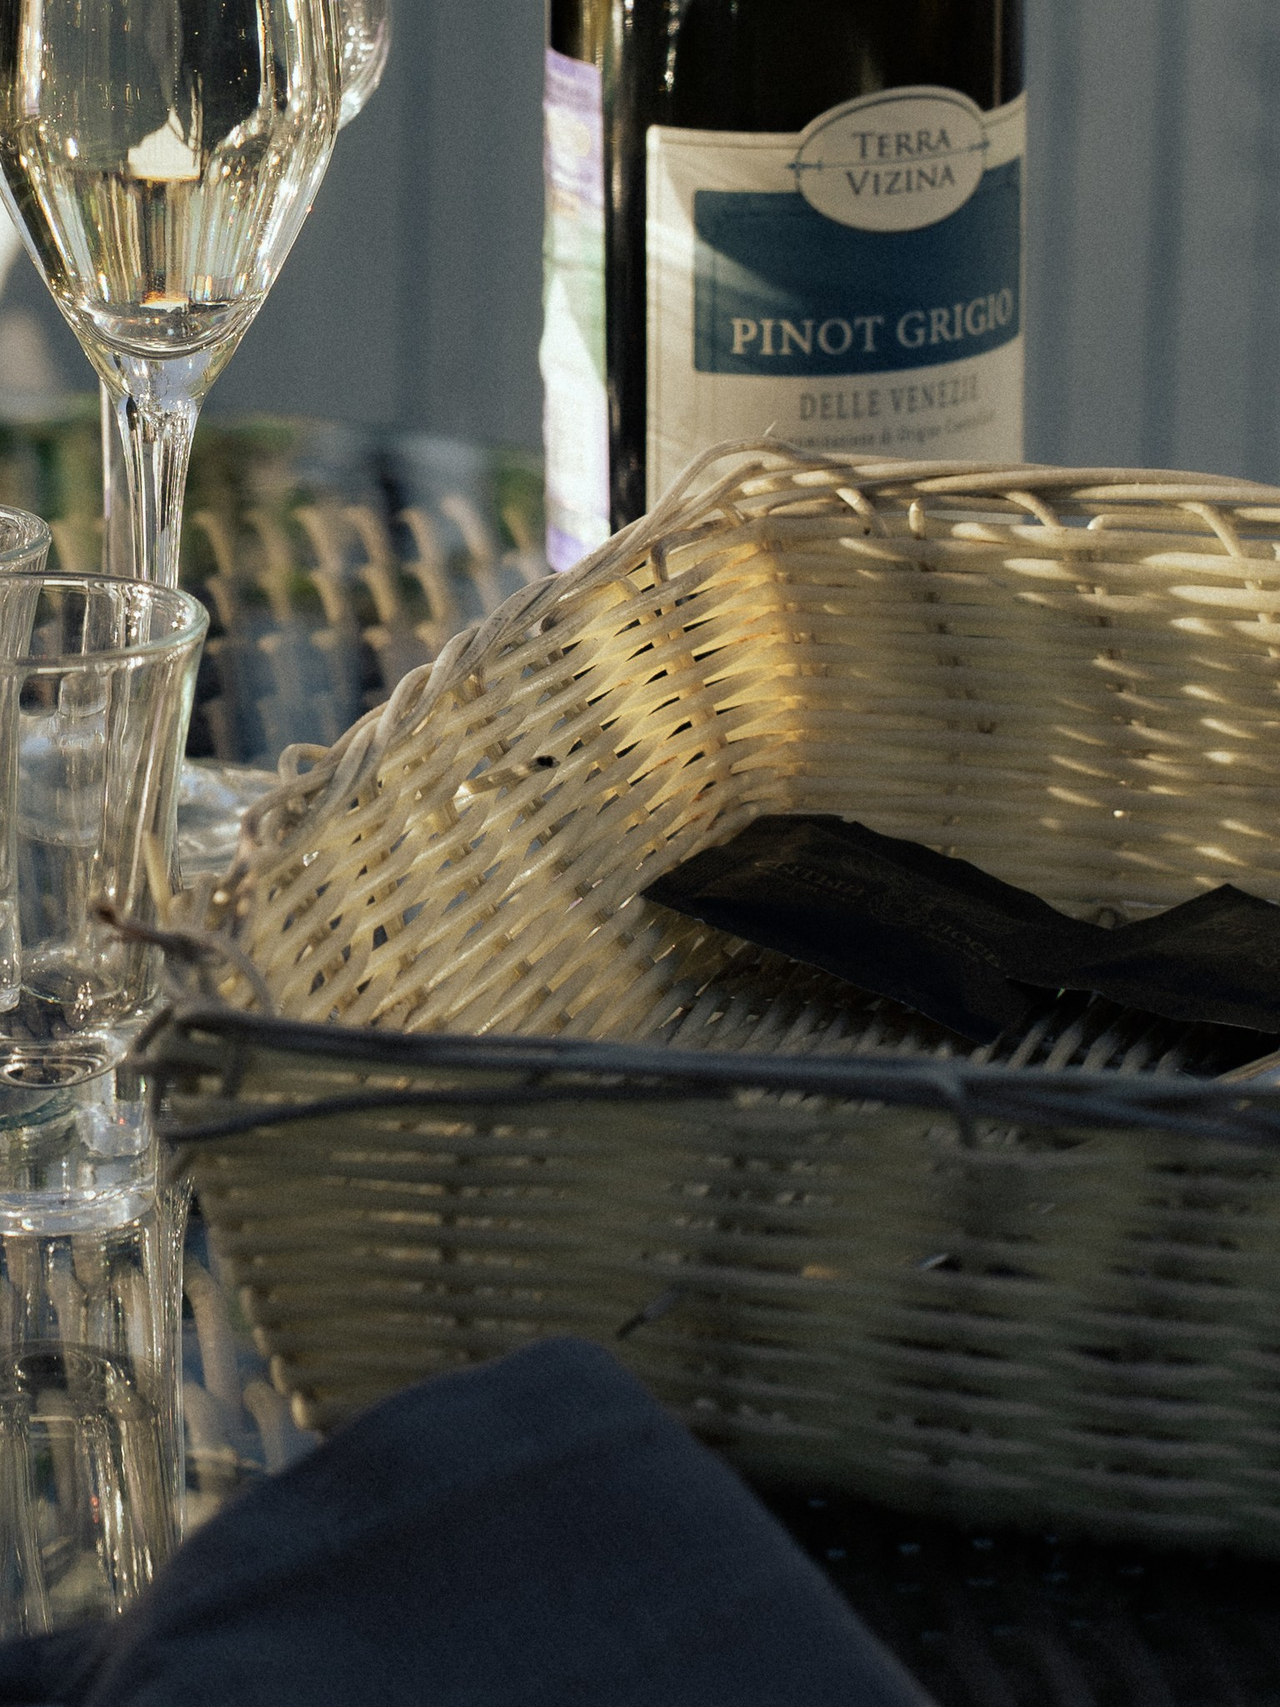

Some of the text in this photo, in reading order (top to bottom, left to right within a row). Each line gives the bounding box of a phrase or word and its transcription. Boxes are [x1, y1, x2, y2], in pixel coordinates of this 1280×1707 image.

[852, 128, 951, 159] TERRA
[846, 165, 956, 196] VIZINA
[730, 288, 1013, 356] PINOT GRIGIO
[799, 389, 880, 421] DELLE
